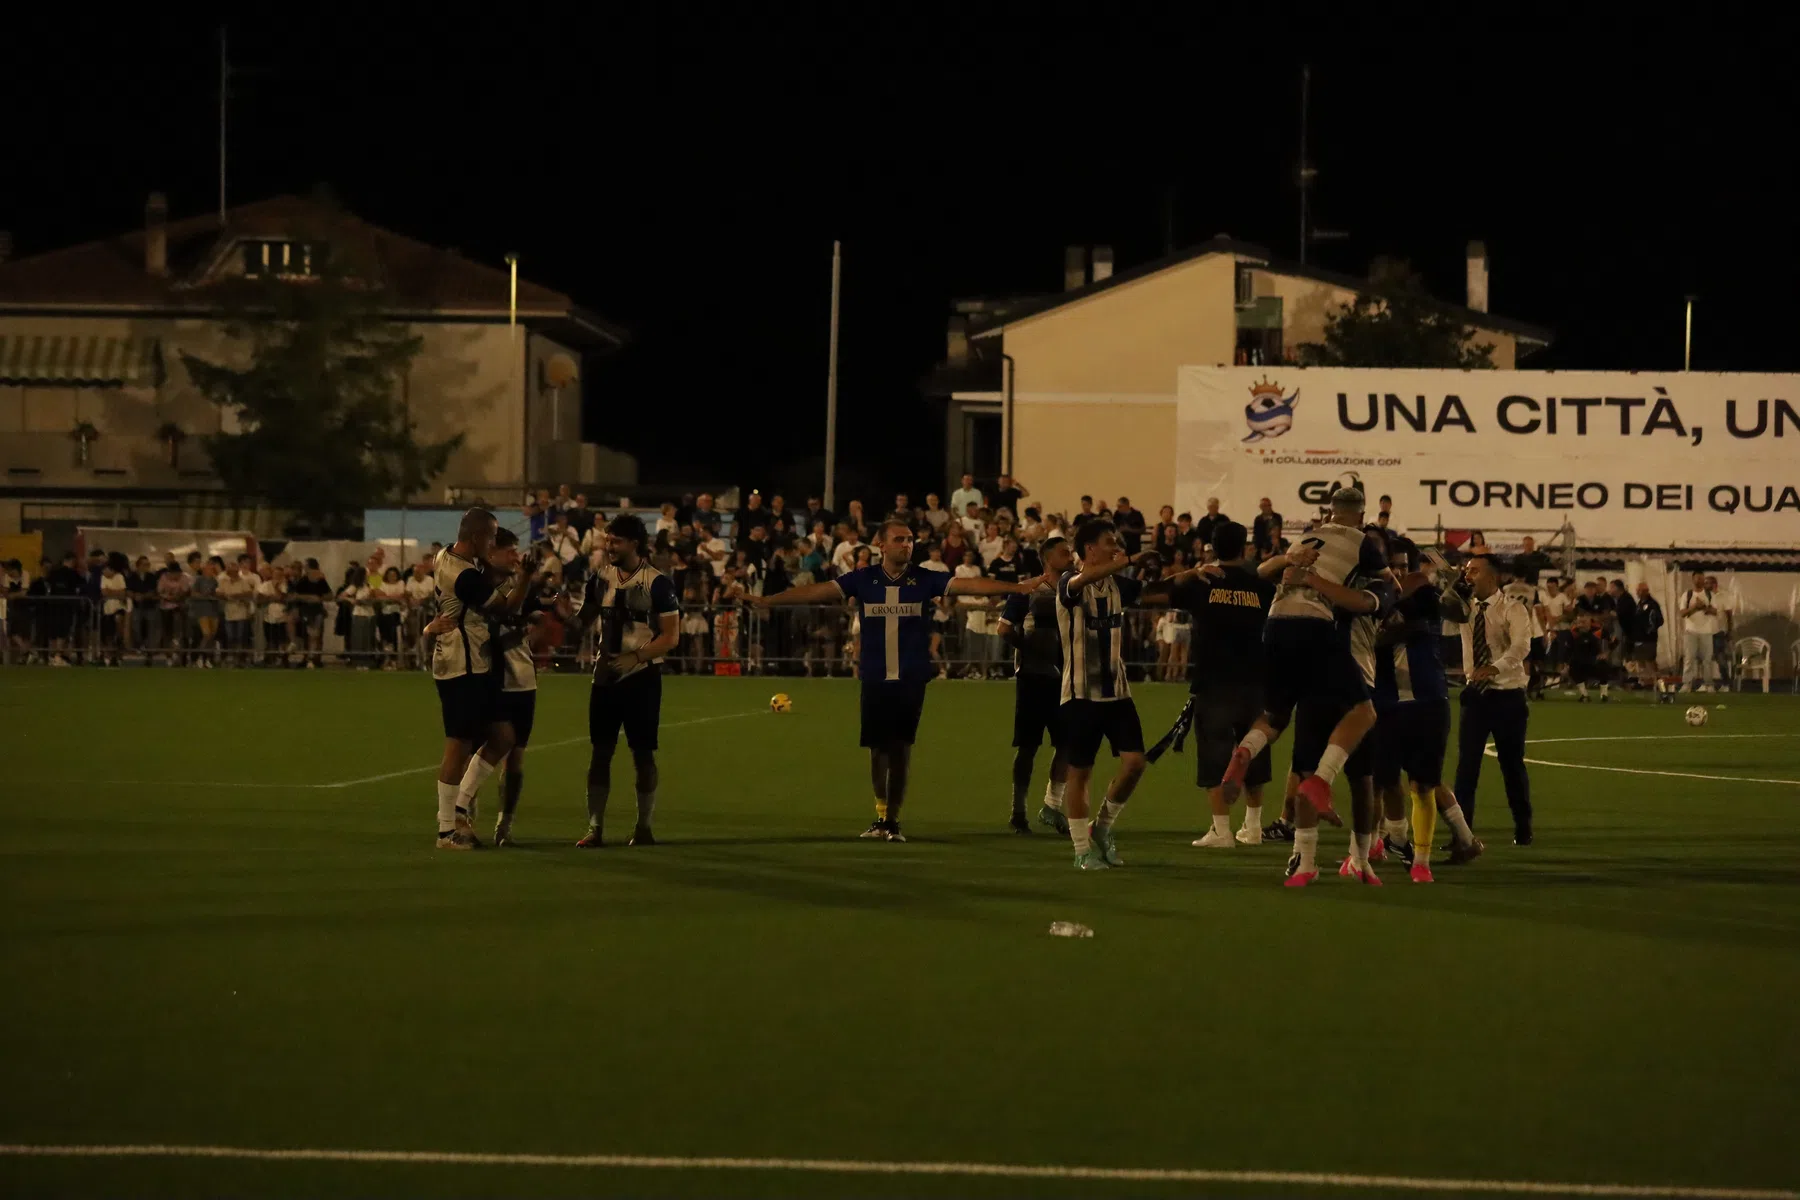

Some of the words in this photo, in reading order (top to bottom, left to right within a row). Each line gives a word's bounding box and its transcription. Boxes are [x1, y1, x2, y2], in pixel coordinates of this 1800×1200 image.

[1338, 393, 1477, 434] UNA
[1498, 387, 1703, 447] CITTÀ,
[1263, 457, 1274, 465] IN
[1276, 456, 1375, 466] COLLABORAZIONE
[1378, 458, 1402, 466] CON
[1421, 481, 1609, 510] TORNEO
[1624, 484, 1693, 511] DEI
[1708, 485, 1800, 515] QUA
[1208, 588, 1232, 604] CROCE
[1232, 590, 1261, 608] STRADA
